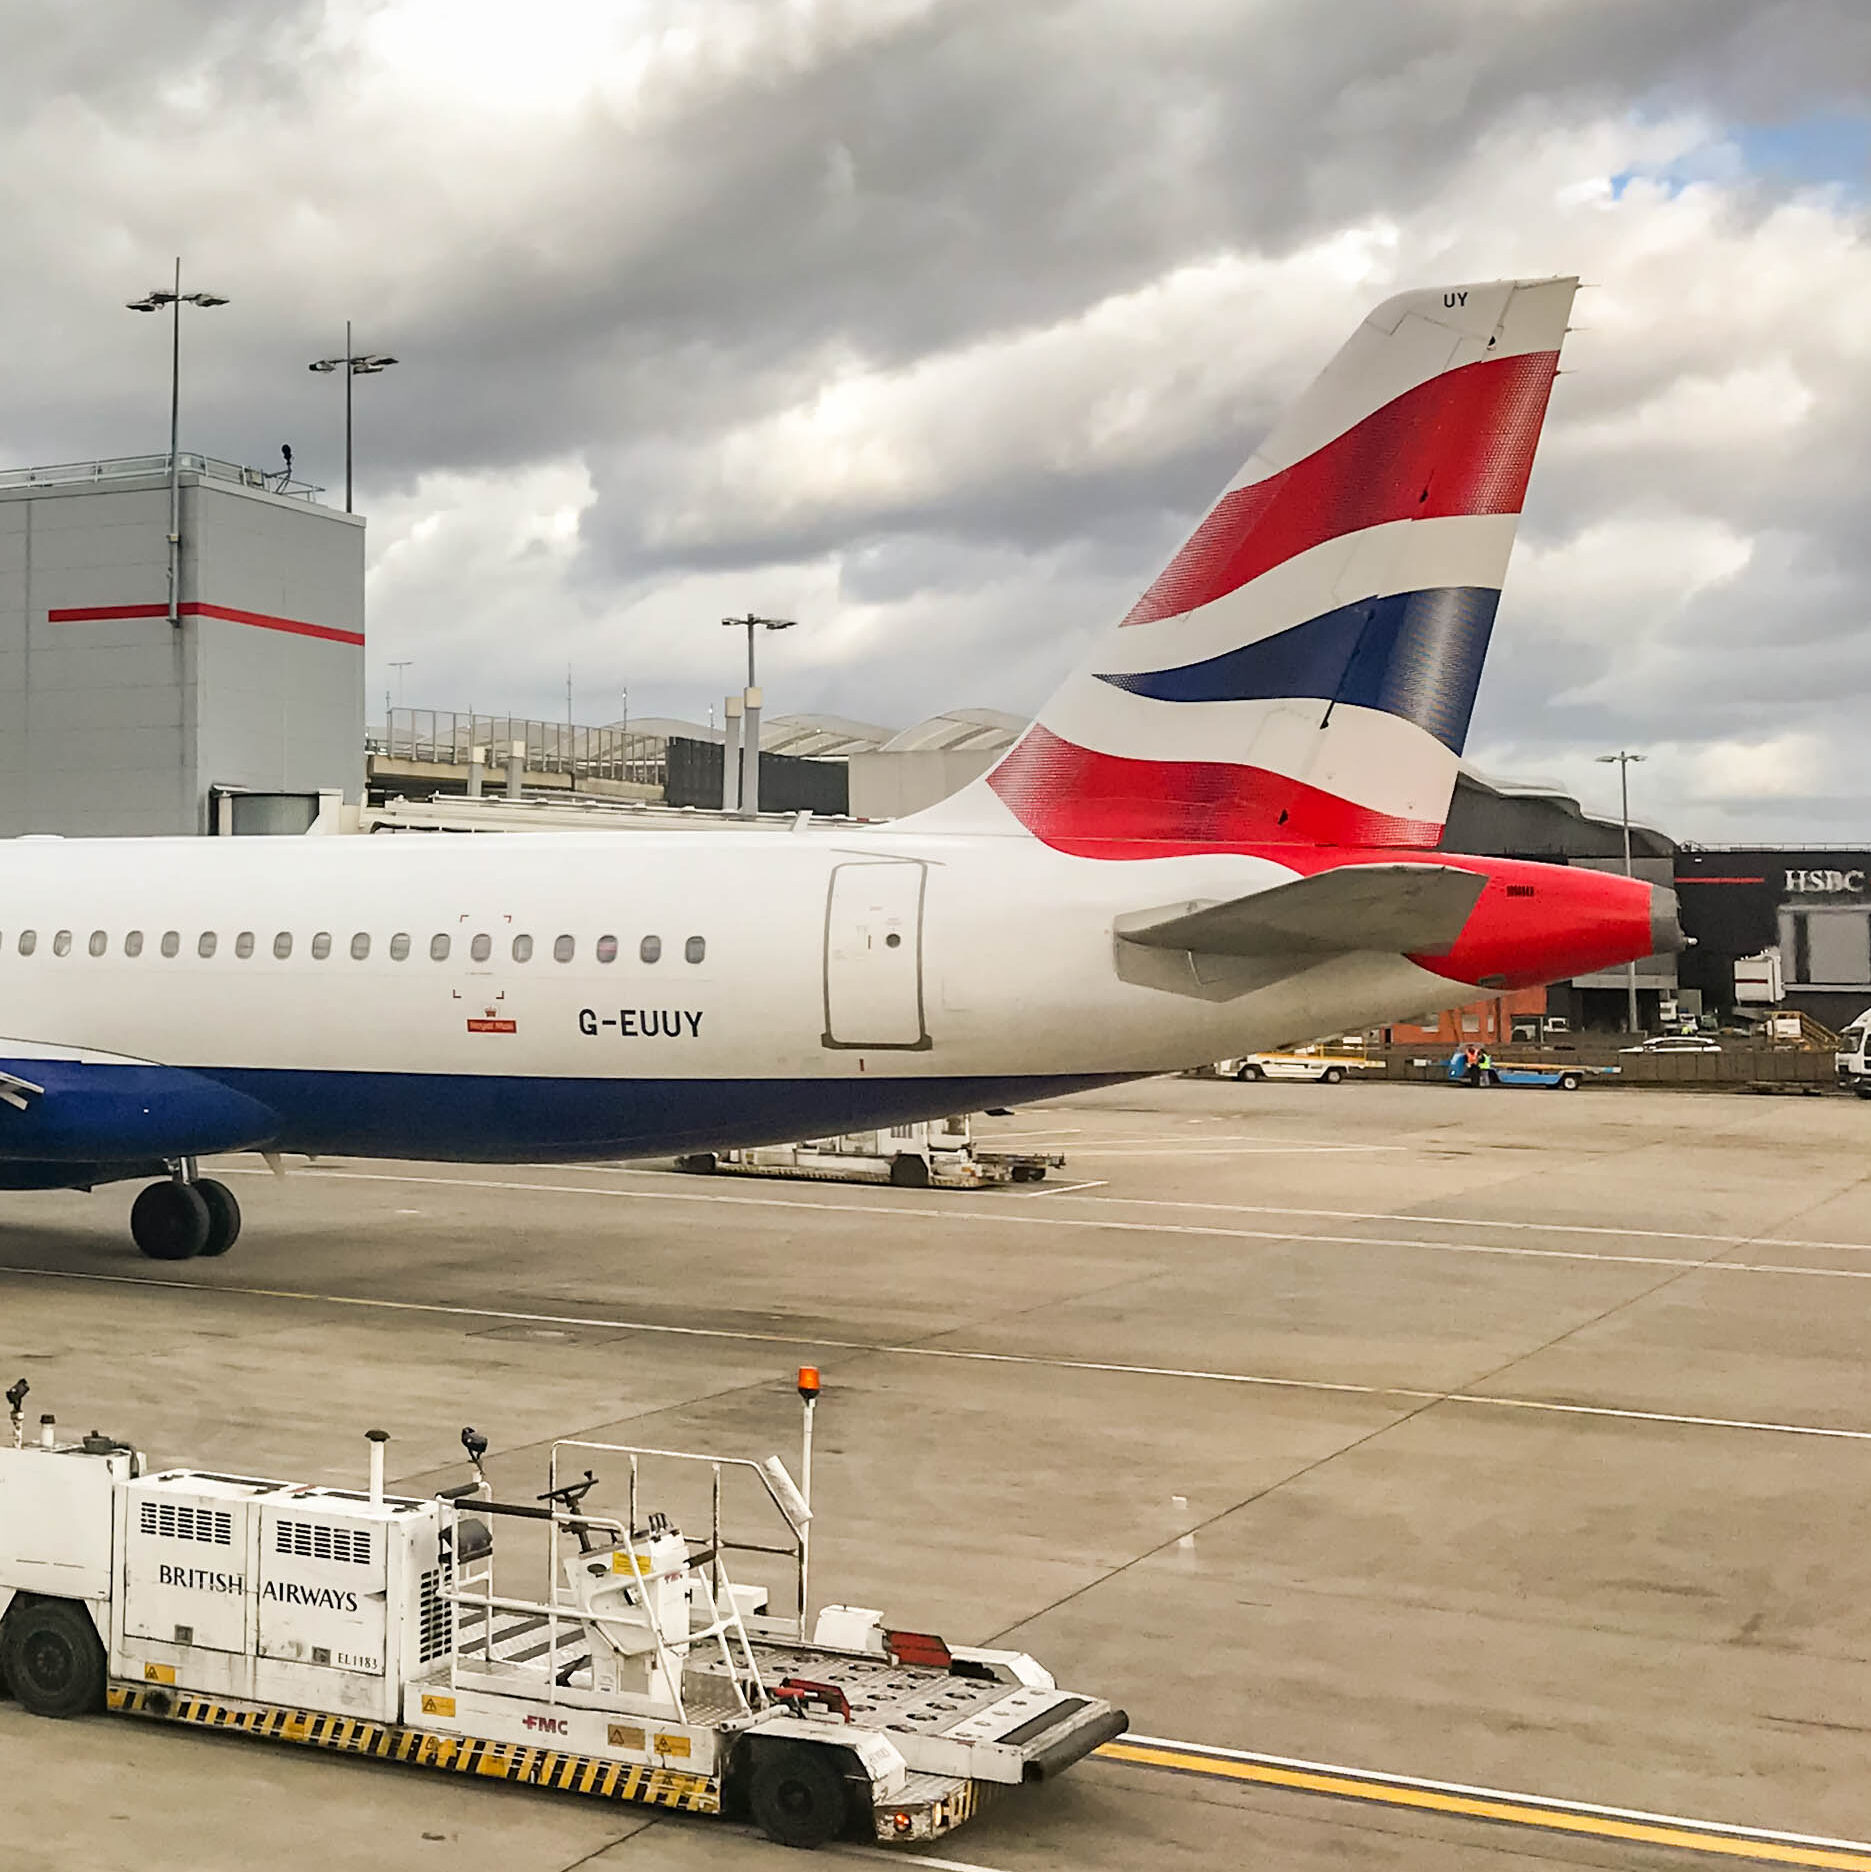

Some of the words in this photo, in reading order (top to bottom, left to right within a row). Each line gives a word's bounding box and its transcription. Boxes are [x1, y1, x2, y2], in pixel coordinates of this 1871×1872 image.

[1443, 291, 1468, 308] UY
[1784, 869, 1866, 894] HSBC
[578, 1008, 704, 1038] G-EUUY
[159, 1564, 244, 1596] BRITISH
[262, 1580, 359, 1613] AIRWAYS
[522, 1714, 569, 1736] FMC
